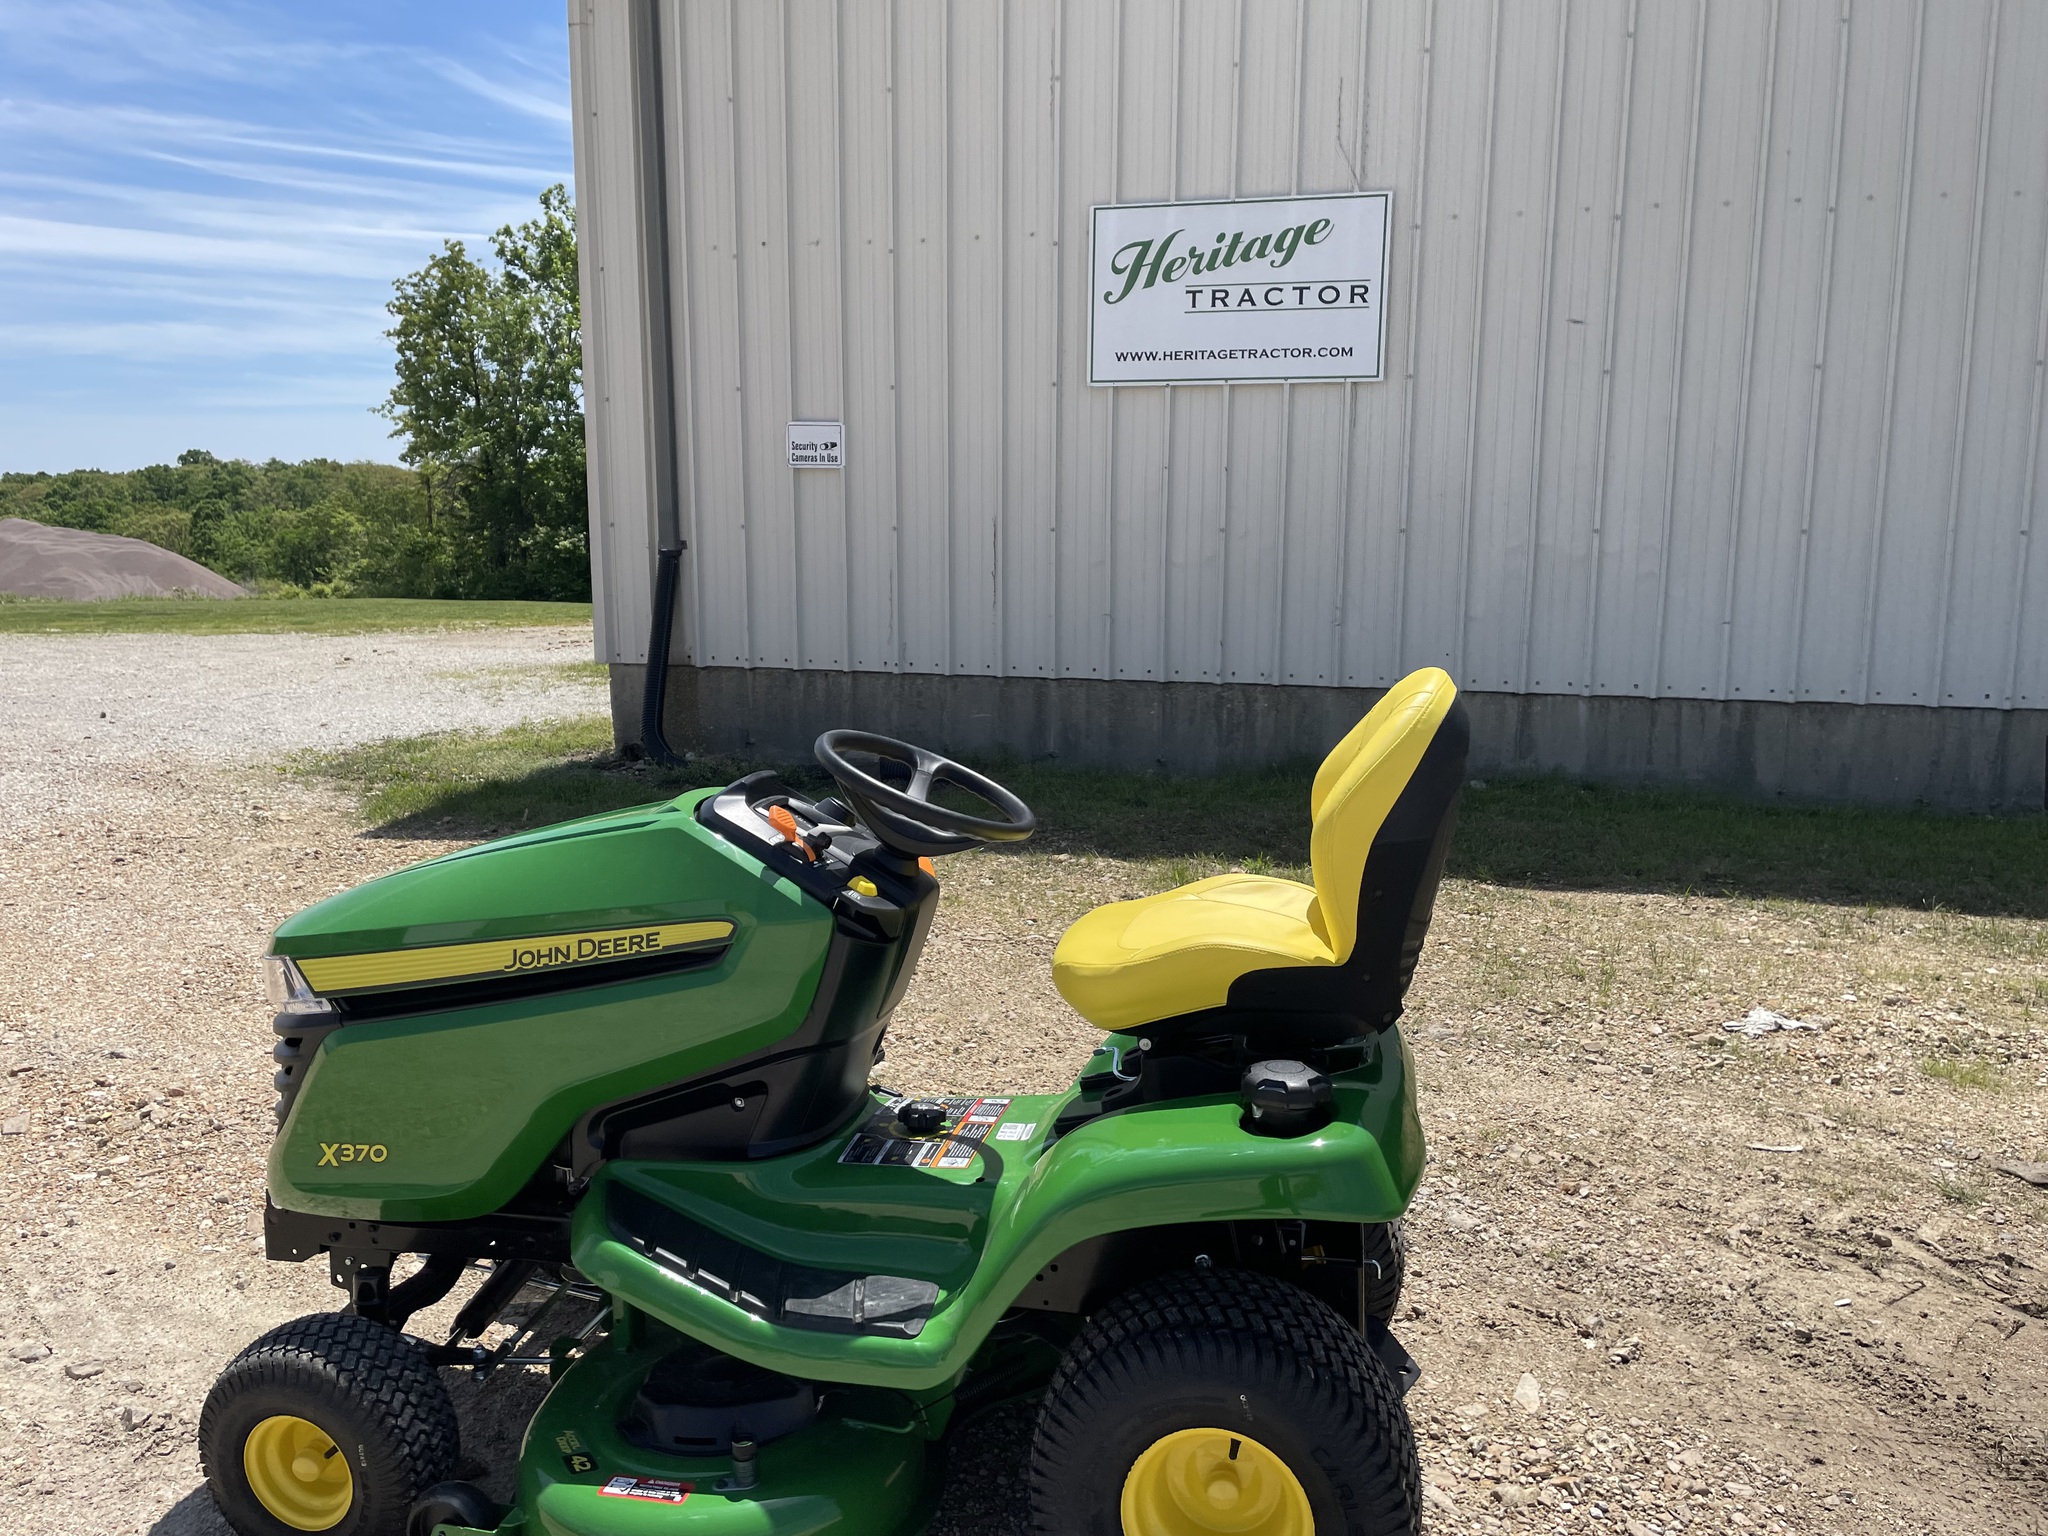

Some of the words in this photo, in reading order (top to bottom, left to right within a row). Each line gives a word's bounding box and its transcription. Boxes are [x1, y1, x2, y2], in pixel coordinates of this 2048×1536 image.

[1103, 218, 1335, 304] Heritage
[1185, 285, 1370, 308] TRACTOR
[1115, 347, 1353, 361] WWW.HERITAGETRACTOR.COM
[791, 441, 818, 453] Security
[791, 452, 818, 463] Cameras
[819, 453, 826, 463] In
[827, 453, 838, 463] Use
[504, 944, 571, 970] JOHN
[577, 931, 661, 960] DEERE
[317, 1142, 388, 1167] X370
[571, 1455, 591, 1472] 42
